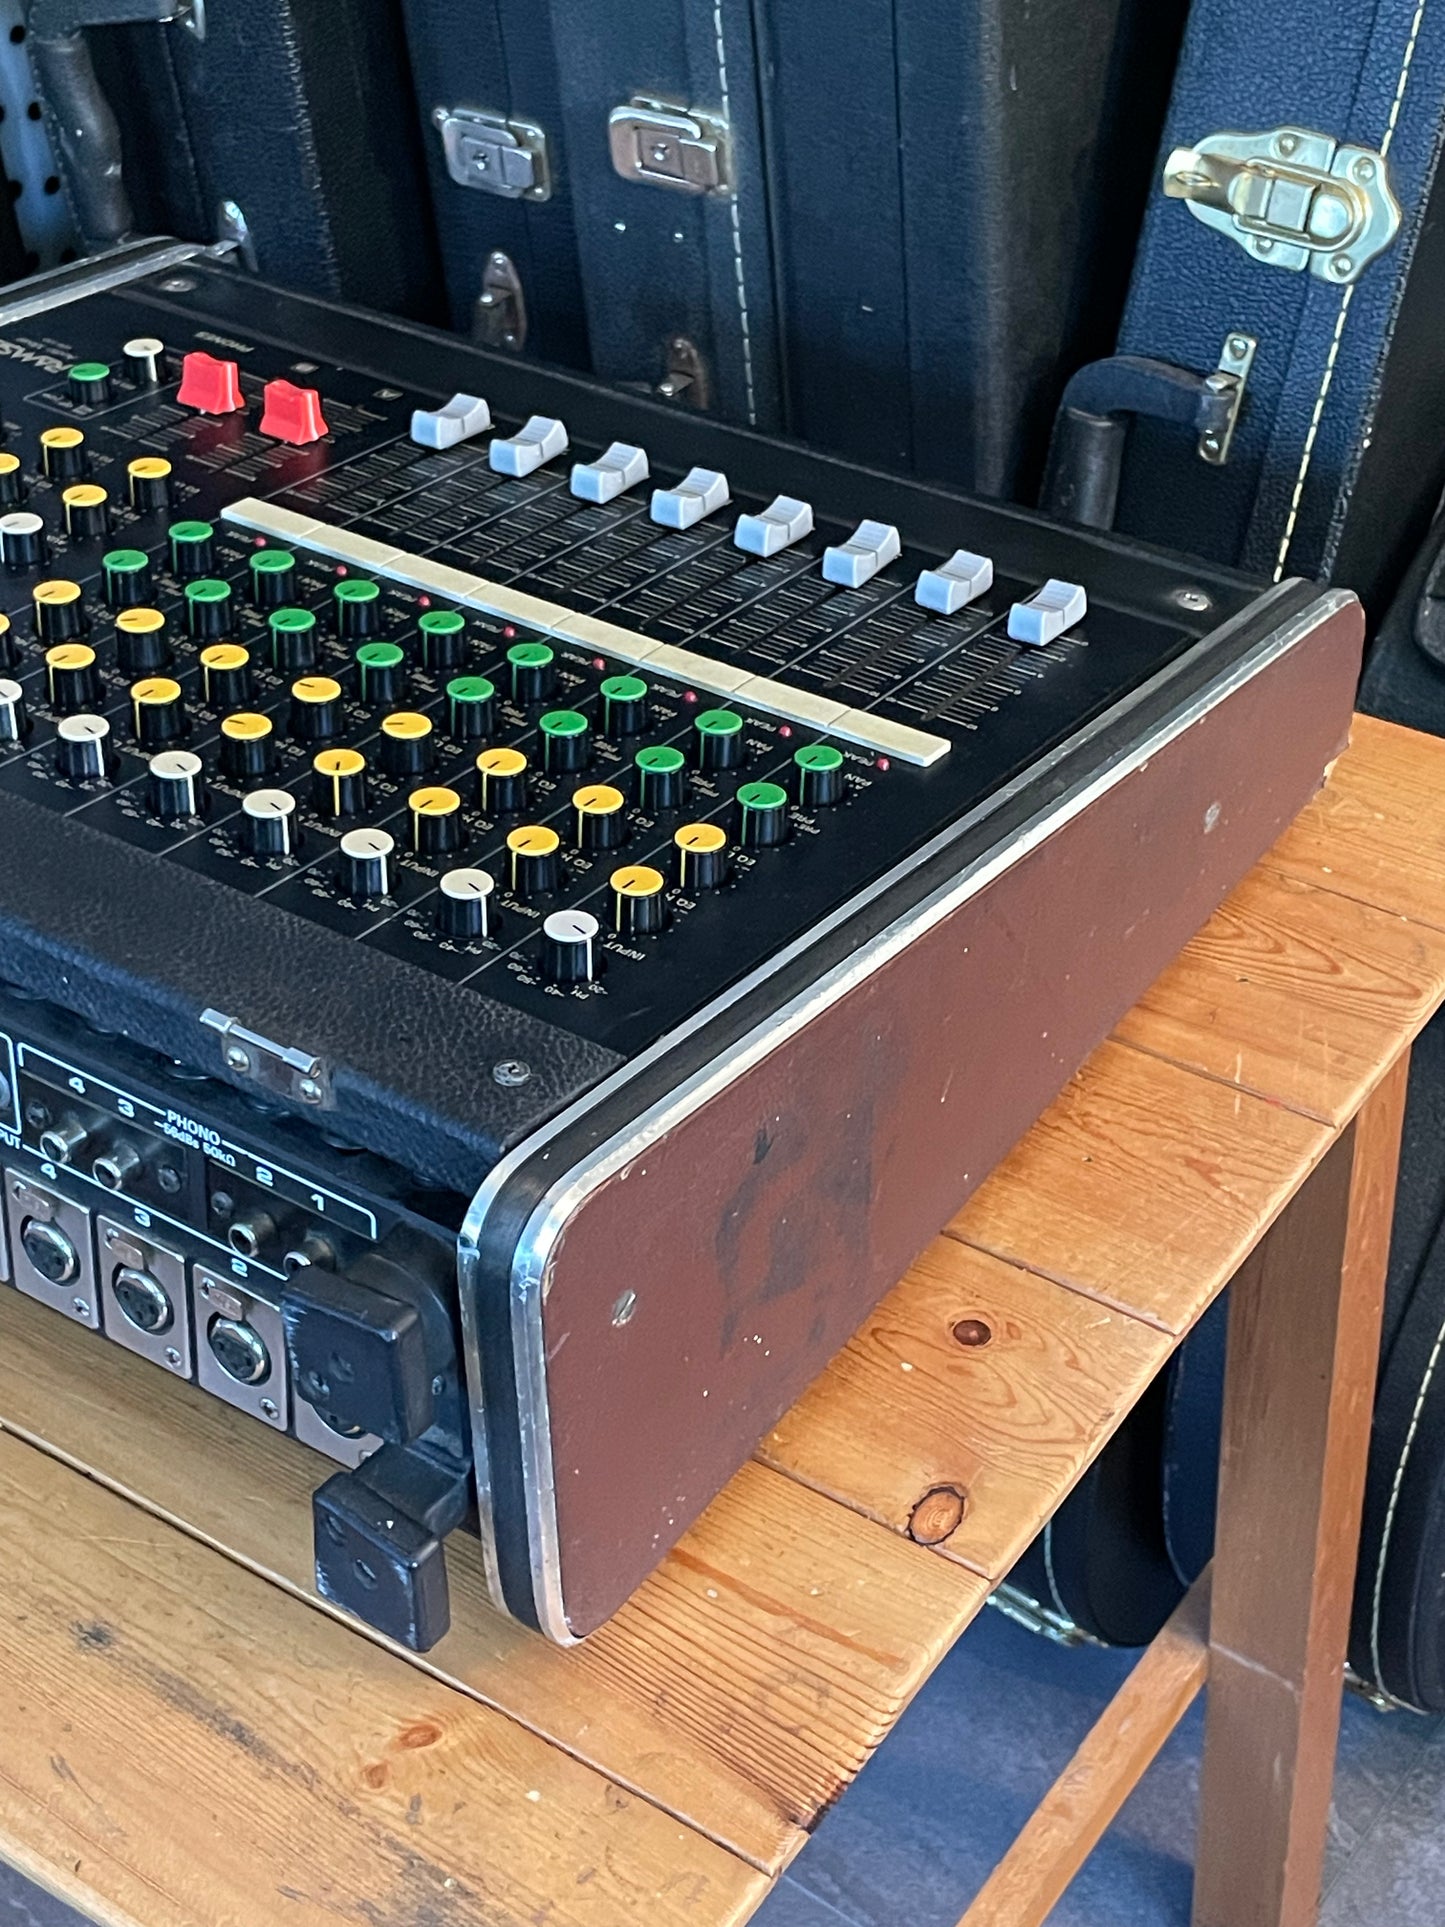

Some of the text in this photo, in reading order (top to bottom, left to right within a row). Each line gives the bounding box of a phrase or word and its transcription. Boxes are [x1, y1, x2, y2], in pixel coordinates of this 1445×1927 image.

[744, 718, 777, 732] PEAK
[443, 744, 463, 755] EQ
[745, 738, 774, 752] PAN
[120, 746, 155, 761] NPUT
[843, 751, 875, 767] PEAK
[538, 779, 557, 790] EQ
[843, 773, 873, 787] PAN
[380, 782, 398, 793] EQ
[303, 820, 342, 837] INPUT
[474, 820, 494, 830] EQ
[635, 817, 655, 828] EQ
[573, 859, 593, 870] EQ
[736, 854, 757, 866] EQ
[399, 859, 439, 878] INPUT
[501, 900, 541, 918] INPUT
[676, 898, 697, 910] EQ
[439, 941, 460, 953] -40
[603, 941, 646, 961] INPUT
[507, 962, 528, 974] -60
[516, 974, 537, 985] -50
[544, 985, 565, 997] -40
[570, 988, 590, 1000] PH
[588, 982, 608, 995] -20
[68, 1077, 86, 1094] 4
[117, 1098, 135, 1118] 3
[167, 1110, 221, 1146] PHONO
[40, 1162, 57, 1180] 4
[255, 1166, 274, 1187] 2
[310, 1193, 325, 1212] 1
[134, 1207, 151, 1228] 3
[231, 1258, 249, 1278] 2
